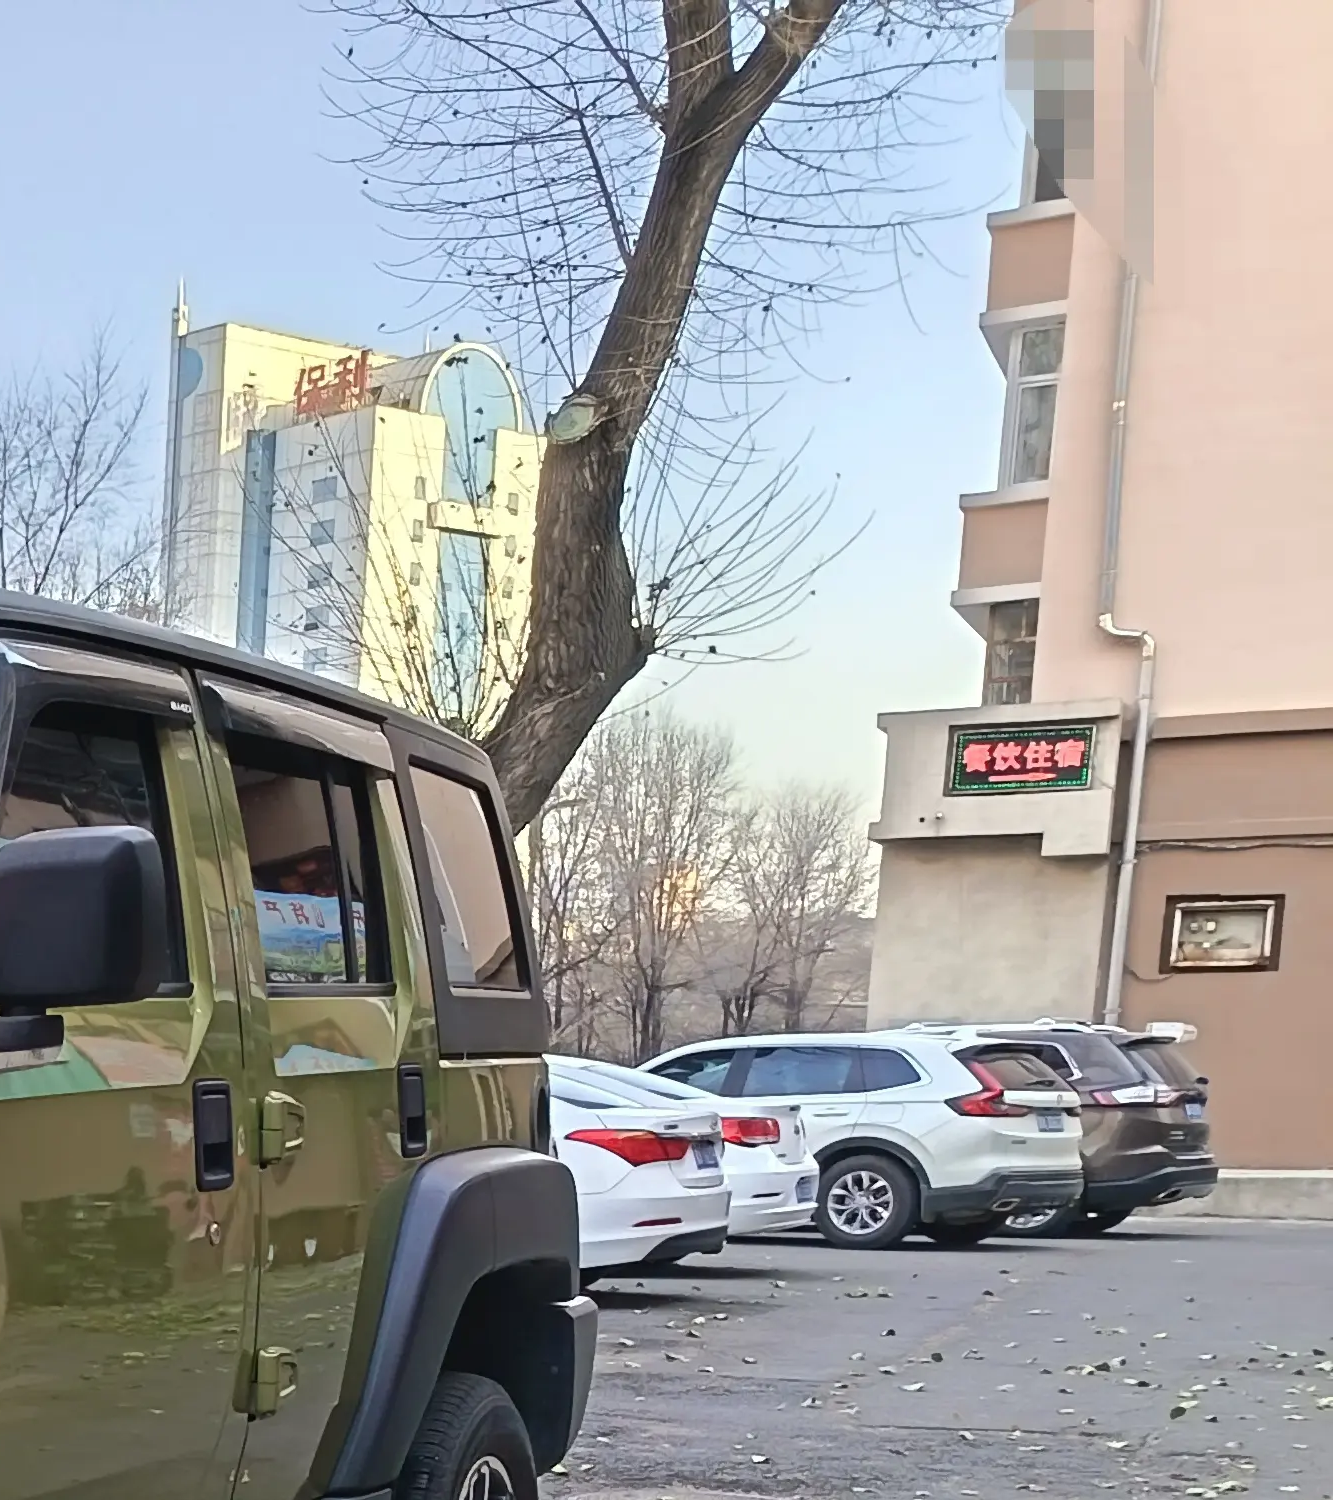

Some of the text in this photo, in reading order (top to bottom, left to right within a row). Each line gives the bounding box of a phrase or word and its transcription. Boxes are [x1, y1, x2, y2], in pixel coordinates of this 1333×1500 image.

[293, 350, 371, 416] 保利
[962, 738, 1085, 773] 餐饮住宿
